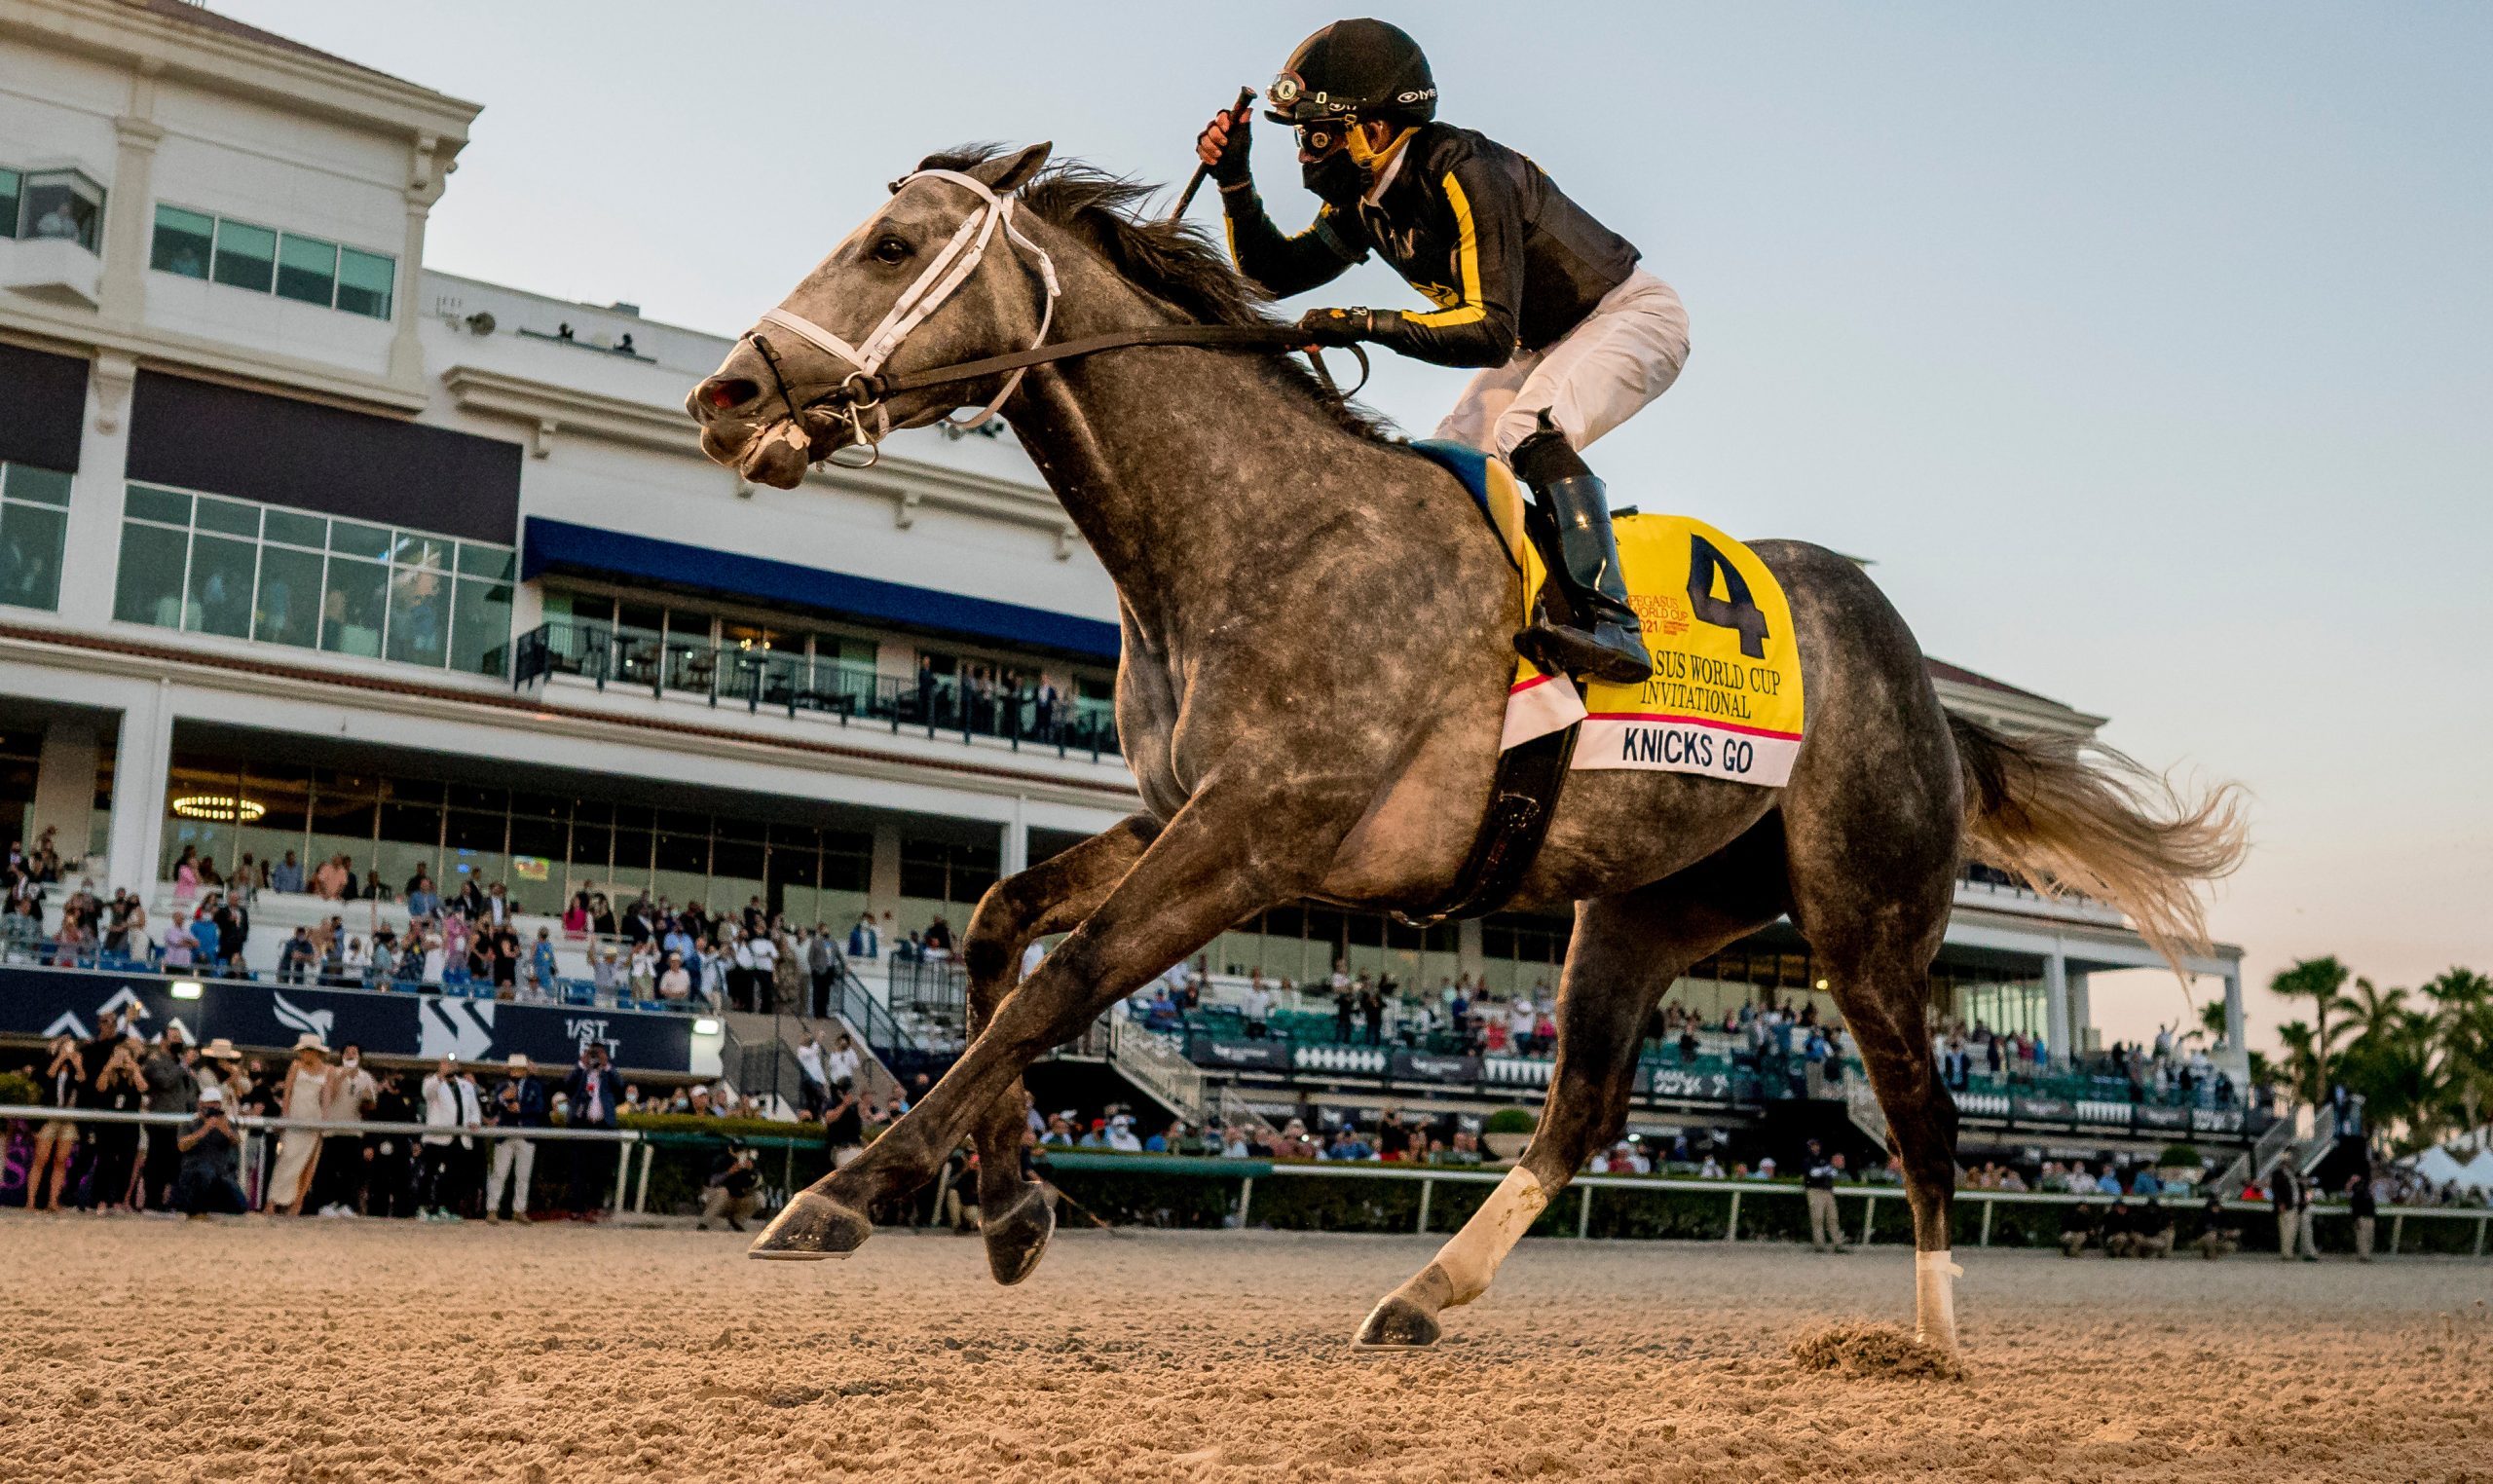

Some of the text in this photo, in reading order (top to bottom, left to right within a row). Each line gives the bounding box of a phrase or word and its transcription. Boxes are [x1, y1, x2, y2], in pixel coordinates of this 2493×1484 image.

[1627, 594, 1679, 610] PEGASUS
[1670, 609, 1689, 622] CUP
[1687, 534, 1769, 659] 4
[1691, 654, 1744, 690] WORLD
[1750, 667, 1781, 696] CUP
[1640, 681, 1751, 719] INVITATIONAL
[1622, 727, 1754, 774] KNICKS GO
